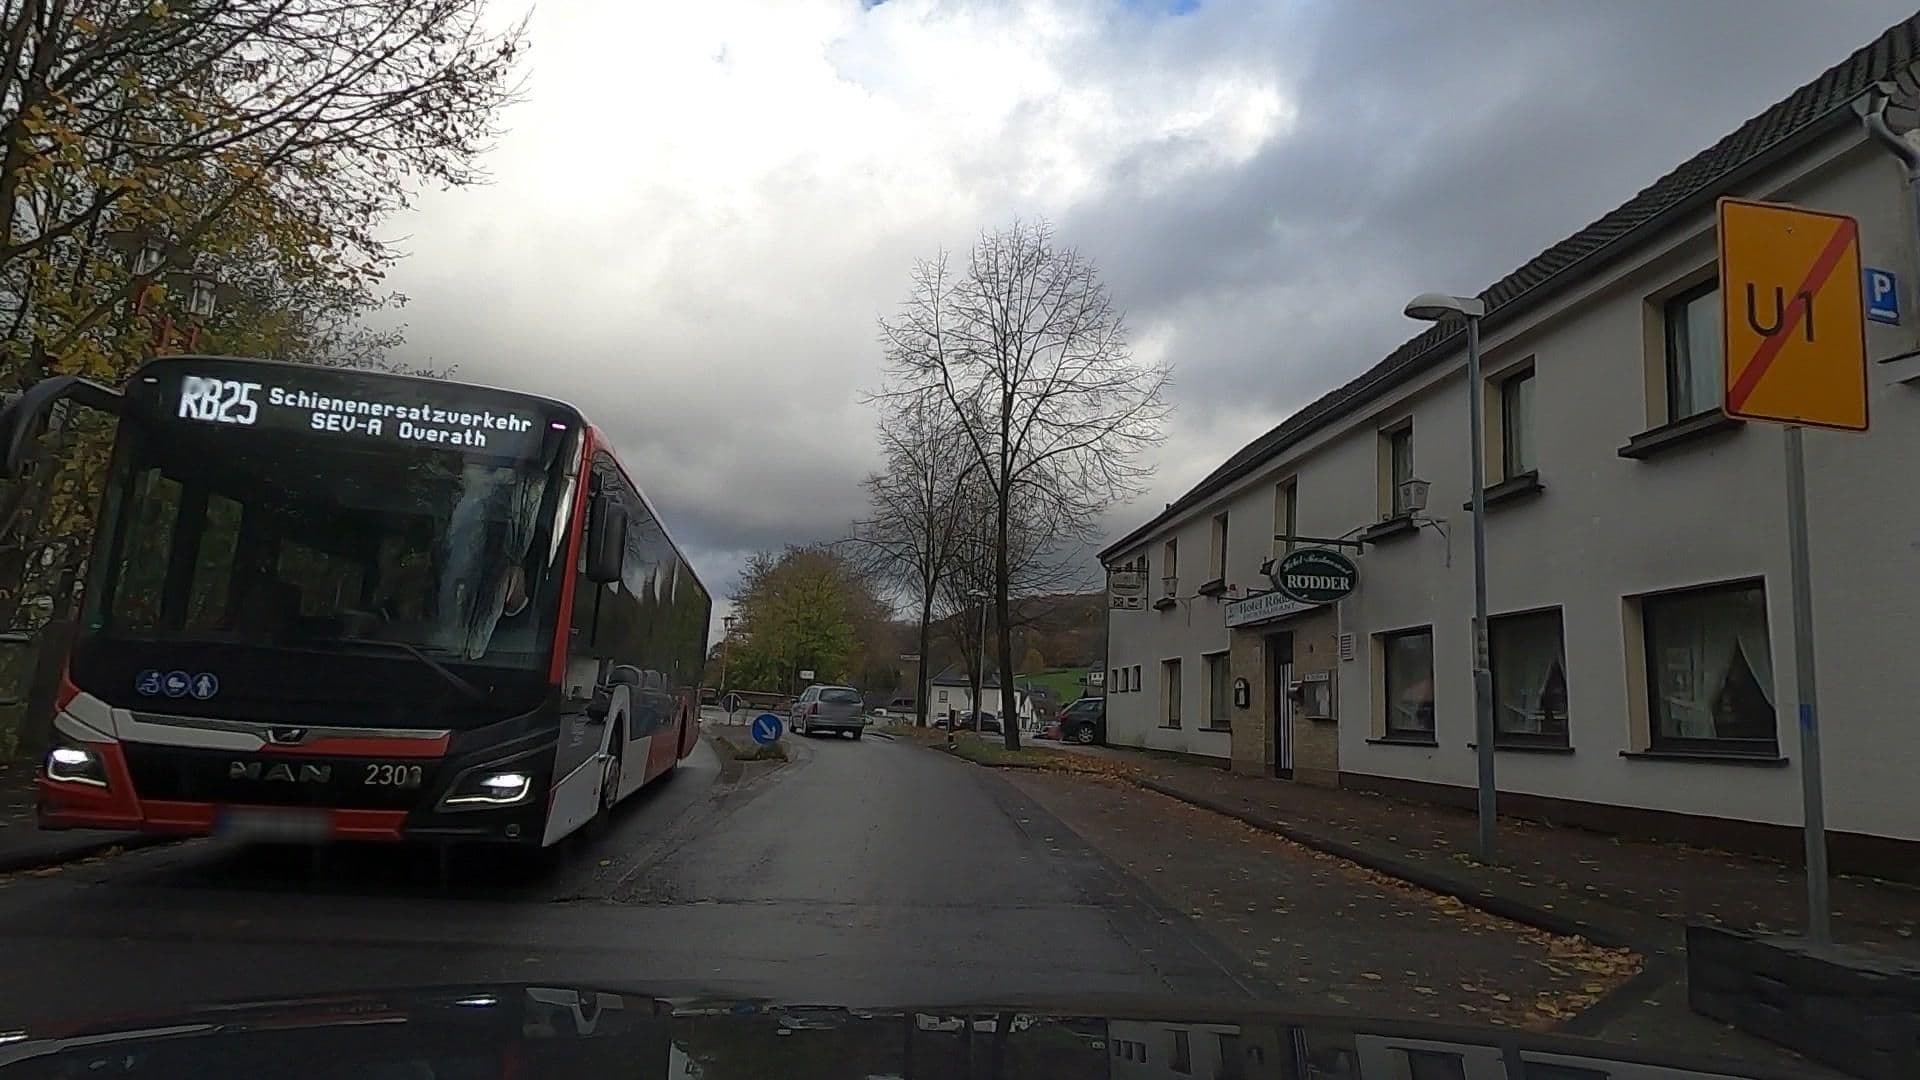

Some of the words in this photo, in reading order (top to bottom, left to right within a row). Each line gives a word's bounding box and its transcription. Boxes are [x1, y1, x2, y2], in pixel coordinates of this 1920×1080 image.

[1872, 273, 1891, 302] P
[178, 375, 262, 425] RB25
[269, 388, 532, 432] Schienenersatzverkehr
[310, 413, 384, 436] SEV-A
[398, 422, 488, 447] Overath
[230, 761, 332, 783] MAN
